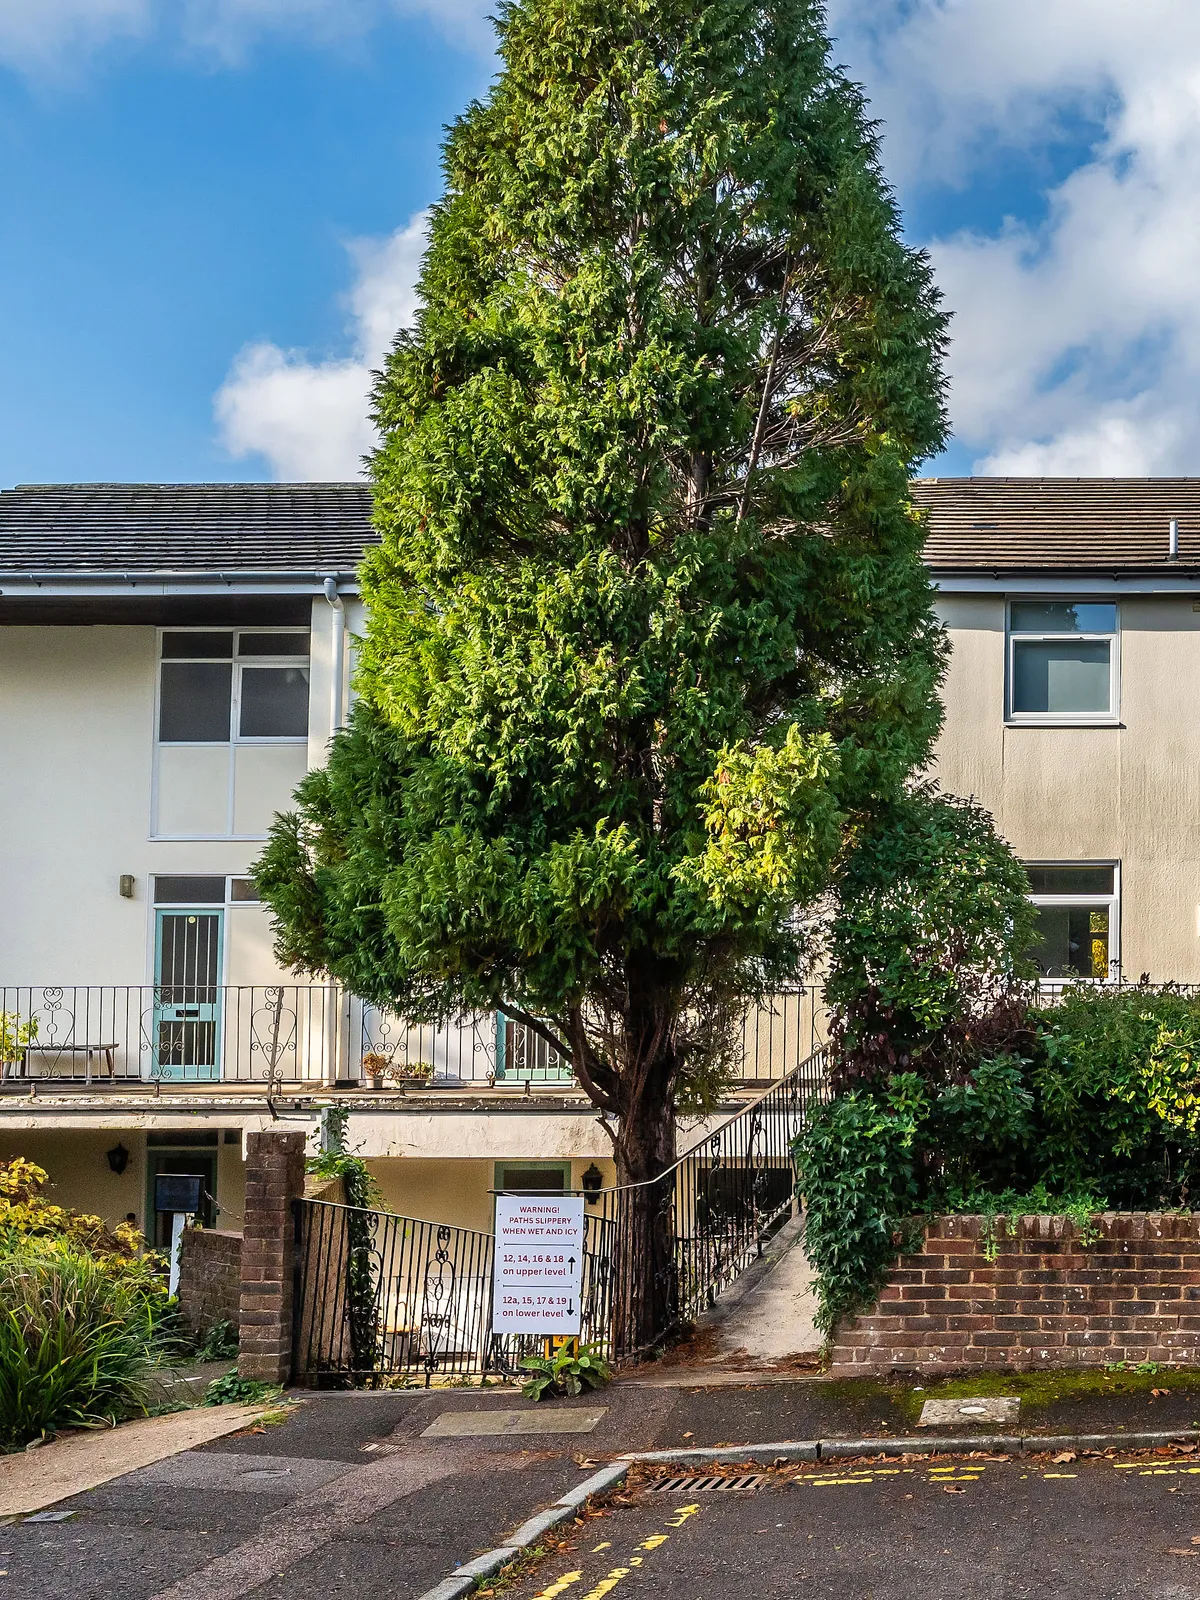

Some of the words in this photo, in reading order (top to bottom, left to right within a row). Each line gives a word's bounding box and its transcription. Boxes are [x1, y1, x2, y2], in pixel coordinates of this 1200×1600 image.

[503, 1254, 516, 1263] 12,
[517, 1255, 531, 1264] 14,
[532, 1255, 544, 1263] 16
[545, 1255, 552, 1263] &
[553, 1255, 564, 1263] 18
[516, 1268, 542, 1276] upper
[544, 1267, 566, 1276] level
[502, 1296, 520, 1305] 12a,
[522, 1296, 535, 1306] 15,
[515, 1309, 541, 1317] lower
[542, 1310, 564, 1318] level
